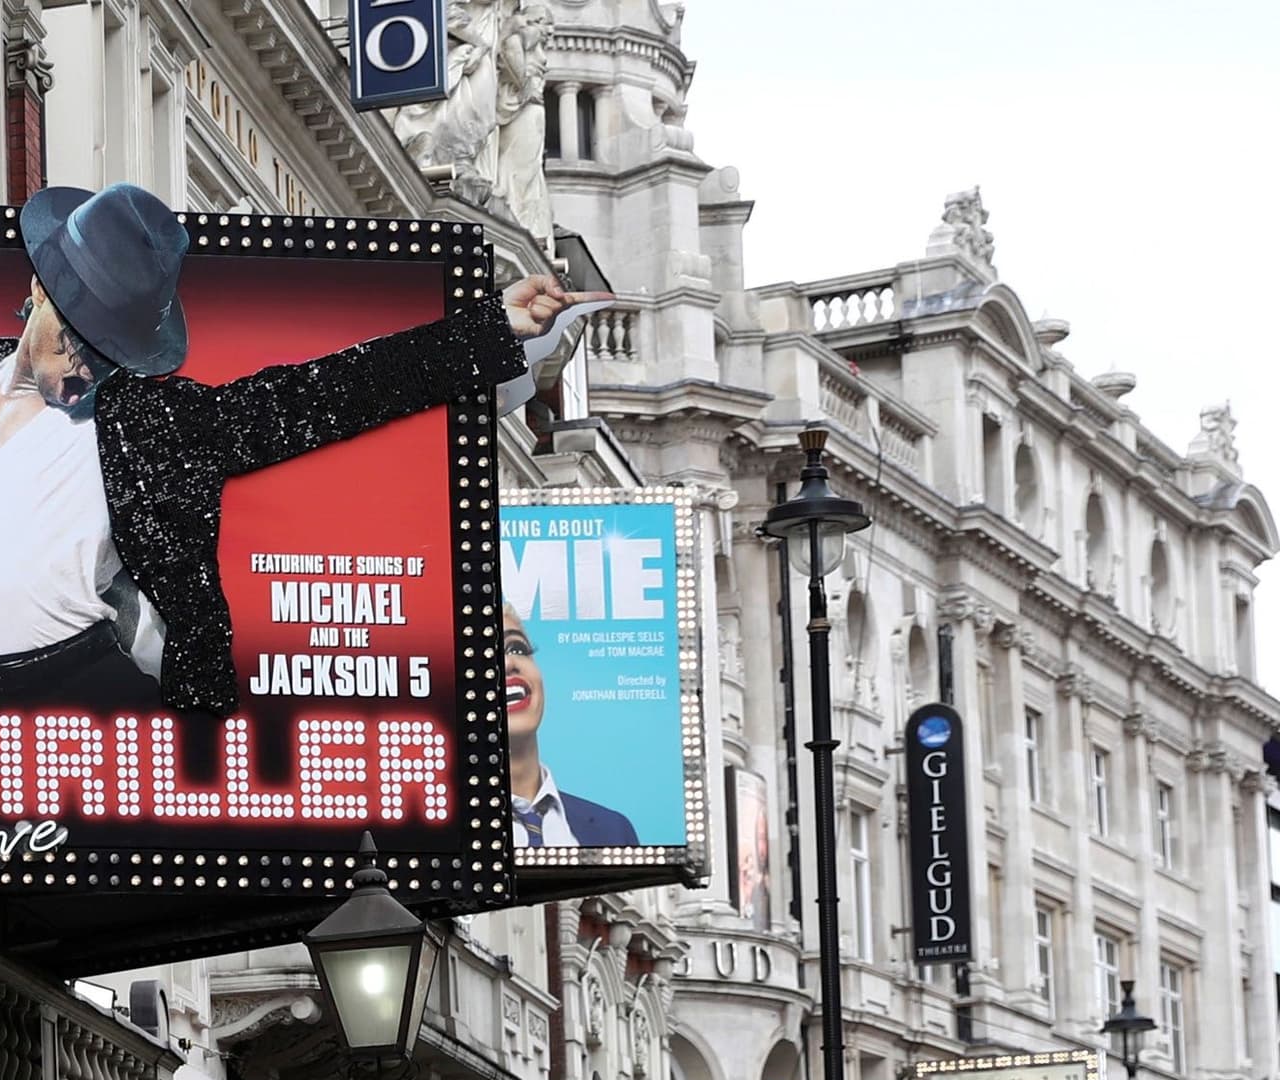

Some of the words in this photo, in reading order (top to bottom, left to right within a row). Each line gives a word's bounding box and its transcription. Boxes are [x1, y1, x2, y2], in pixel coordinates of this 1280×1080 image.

[548, 519, 604, 537] ABOUT
[250, 553, 325, 575] FEATURING
[327, 554, 354, 575] THE
[356, 555, 404, 576] SONGS
[407, 556, 425, 577] OF
[271, 582, 408, 626] MICHAEL
[309, 627, 338, 648] AND
[340, 627, 370, 648] THE
[558, 633, 570, 643] BY
[572, 633, 590, 643] DAN
[592, 632, 635, 643] GILLESPIE
[637, 632, 665, 643] SELLS
[608, 647, 626, 657] TOM
[628, 646, 665, 657] MACRAE
[249, 655, 397, 697] JACKSON
[407, 656, 430, 698] 5
[618, 675, 654, 686] Directed
[656, 675, 667, 687] by
[572, 691, 616, 701] JONATHAN
[618, 689, 667, 700] BUTTERELL
[922, 751, 956, 942] GIELGUD
